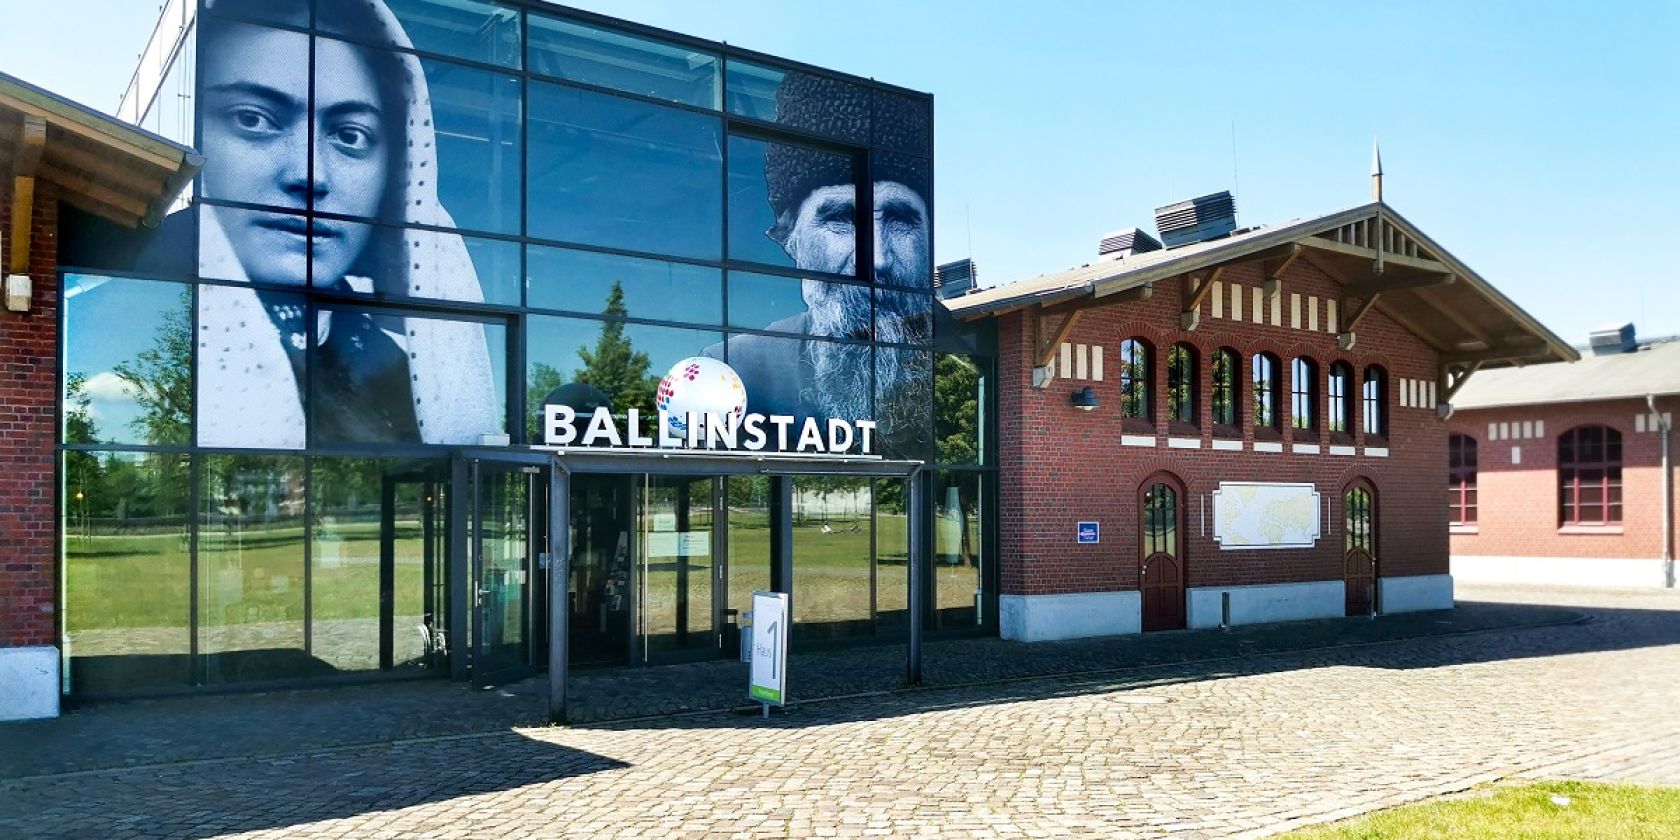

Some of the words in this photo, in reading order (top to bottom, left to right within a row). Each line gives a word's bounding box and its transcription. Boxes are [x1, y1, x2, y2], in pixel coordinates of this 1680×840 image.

[544, 404, 876, 454] BALLINSTADT
[757, 643, 772, 658] Haus
[767, 621, 777, 679] 1
